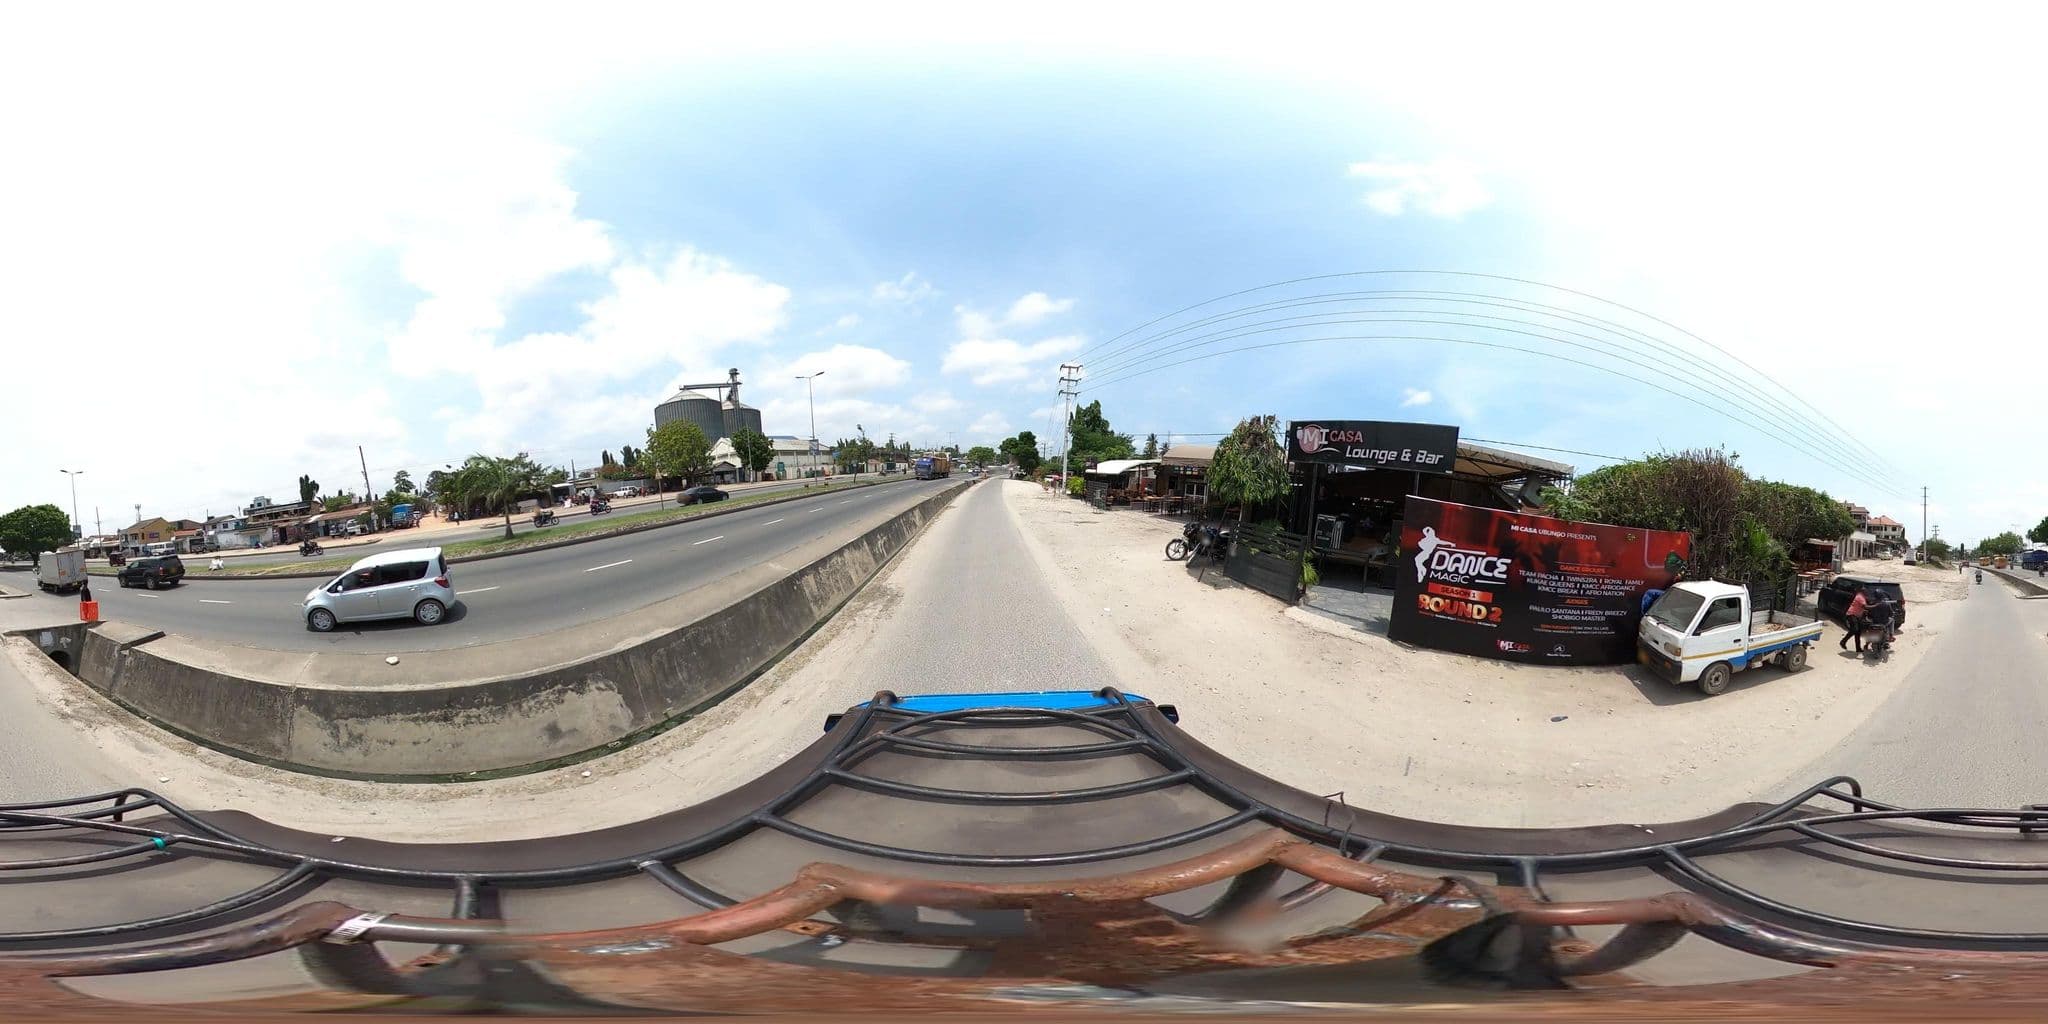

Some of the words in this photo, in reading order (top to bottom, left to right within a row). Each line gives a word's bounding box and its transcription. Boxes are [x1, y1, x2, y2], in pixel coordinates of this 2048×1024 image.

[1330, 430, 1363, 443] CASA
[1345, 445, 1396, 464] Lounge
[1400, 449, 1411, 462] &
[1415, 450, 1444, 465] Bar
[1510, 524, 1520, 532] MI
[1520, 526, 1538, 534] CASA
[1538, 528, 1566, 538] UBUNGO
[1566, 532, 1597, 541] PRESENTS
[1431, 551, 1512, 578] DANCE
[1430, 570, 1470, 584] MAGIC
[1519, 569, 1537, 577] TEAM
[1548, 580, 1575, 588] QUEENS
[1441, 586, 1471, 598] SEASON
[1418, 594, 1487, 620] ROUND
[1487, 606, 1504, 622] 2
[1551, 608, 1581, 616] SANTANA
